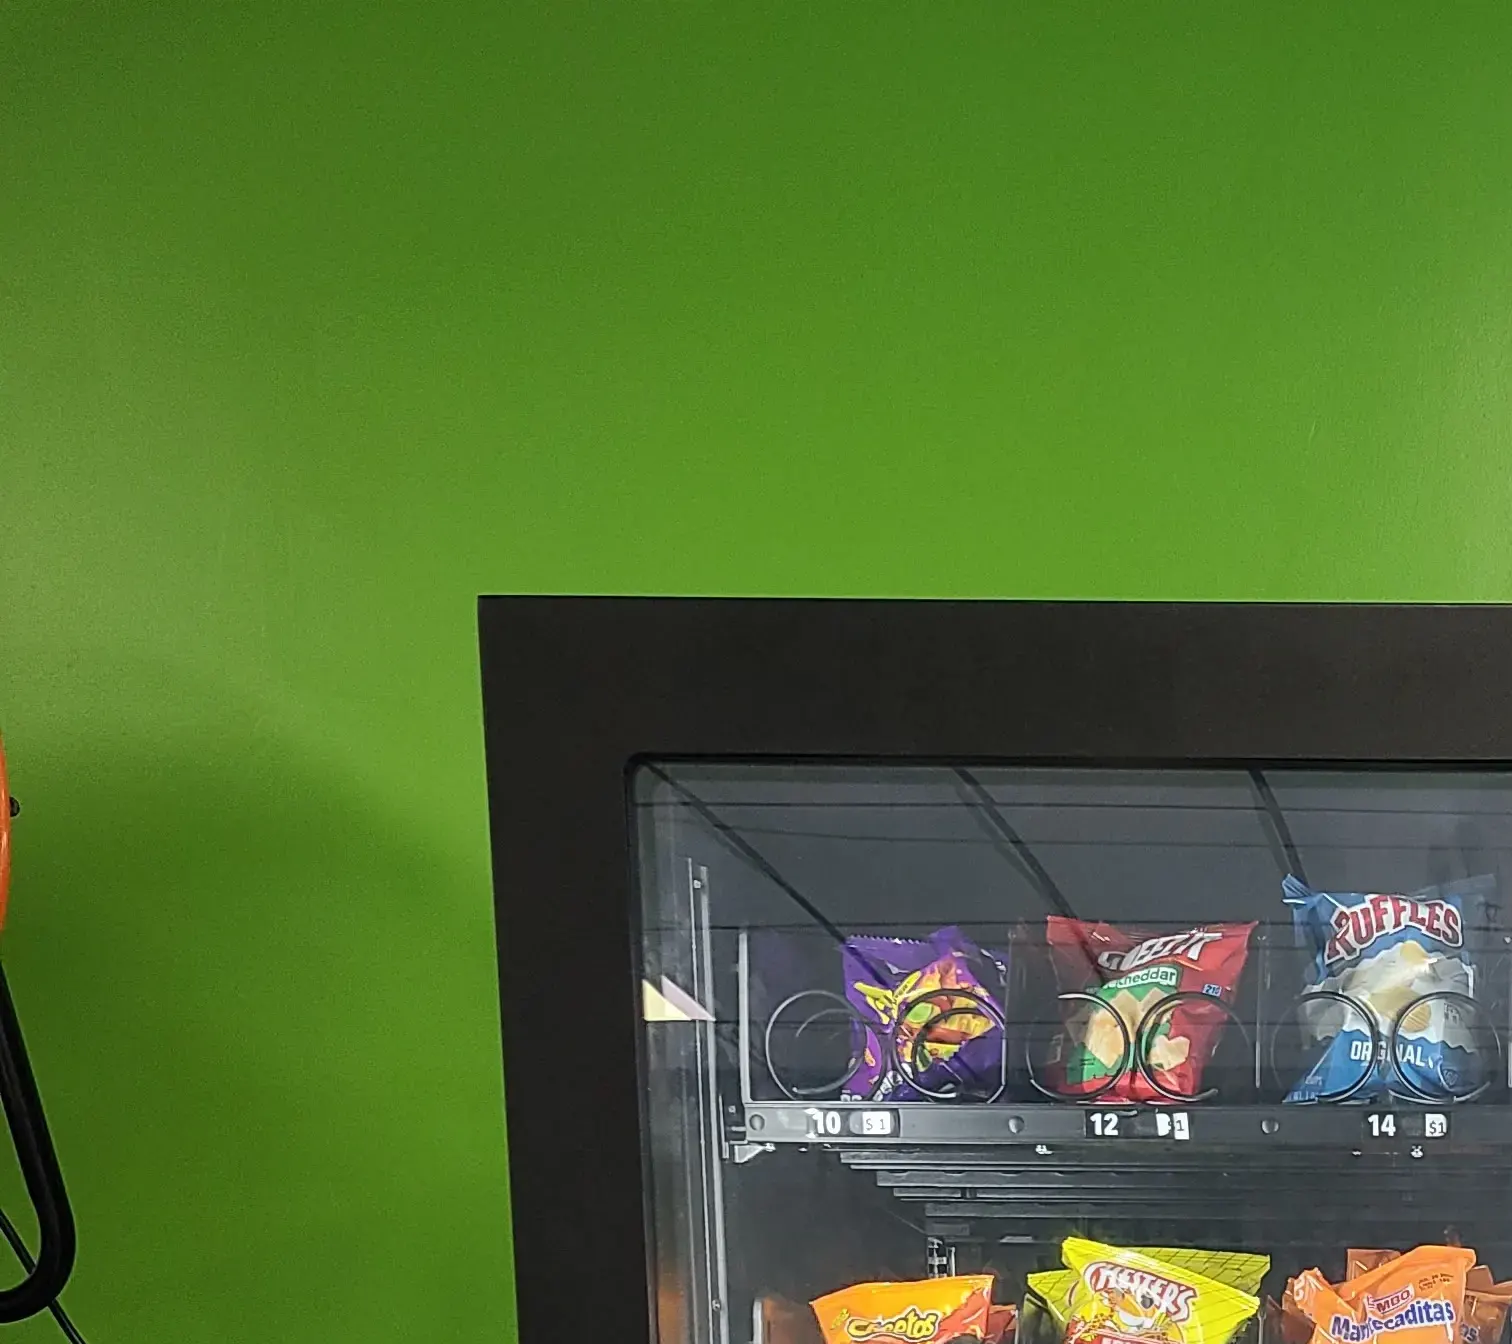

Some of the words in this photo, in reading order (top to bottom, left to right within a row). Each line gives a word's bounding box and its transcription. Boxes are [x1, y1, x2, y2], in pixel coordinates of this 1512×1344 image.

[1326, 894, 1462, 963] RUFFLES
[813, 1111, 841, 1134] 10
[1090, 1112, 1118, 1136] 12
[1368, 1114, 1396, 1136] 14
[1428, 1120, 1446, 1135] $1
